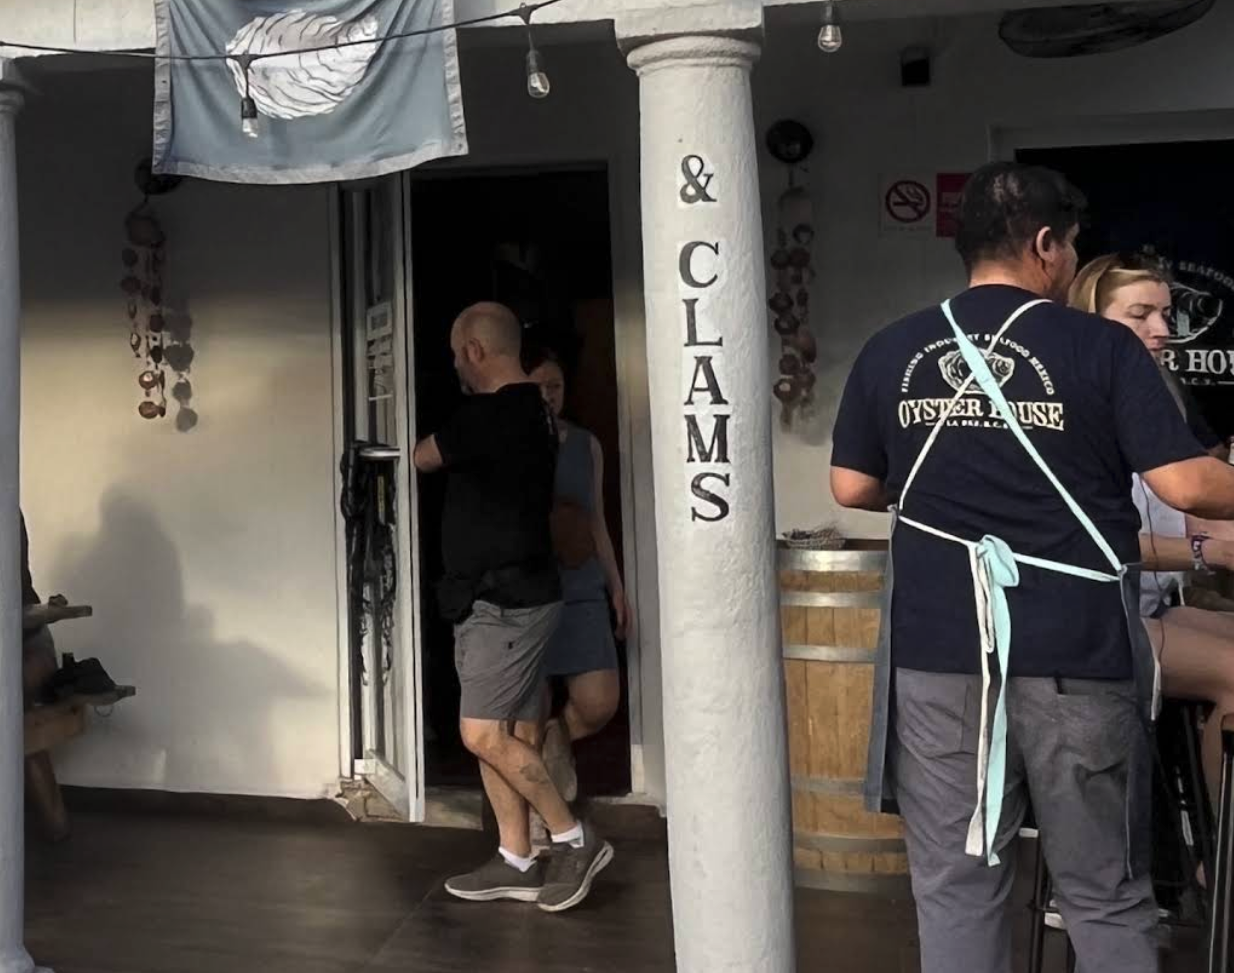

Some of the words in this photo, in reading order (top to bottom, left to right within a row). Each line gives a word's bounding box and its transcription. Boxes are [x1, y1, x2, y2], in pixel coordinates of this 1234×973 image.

[679, 154, 717, 204] &
[679, 241, 731, 522] CLAMS
[898, 397, 984, 429] OYSTER
